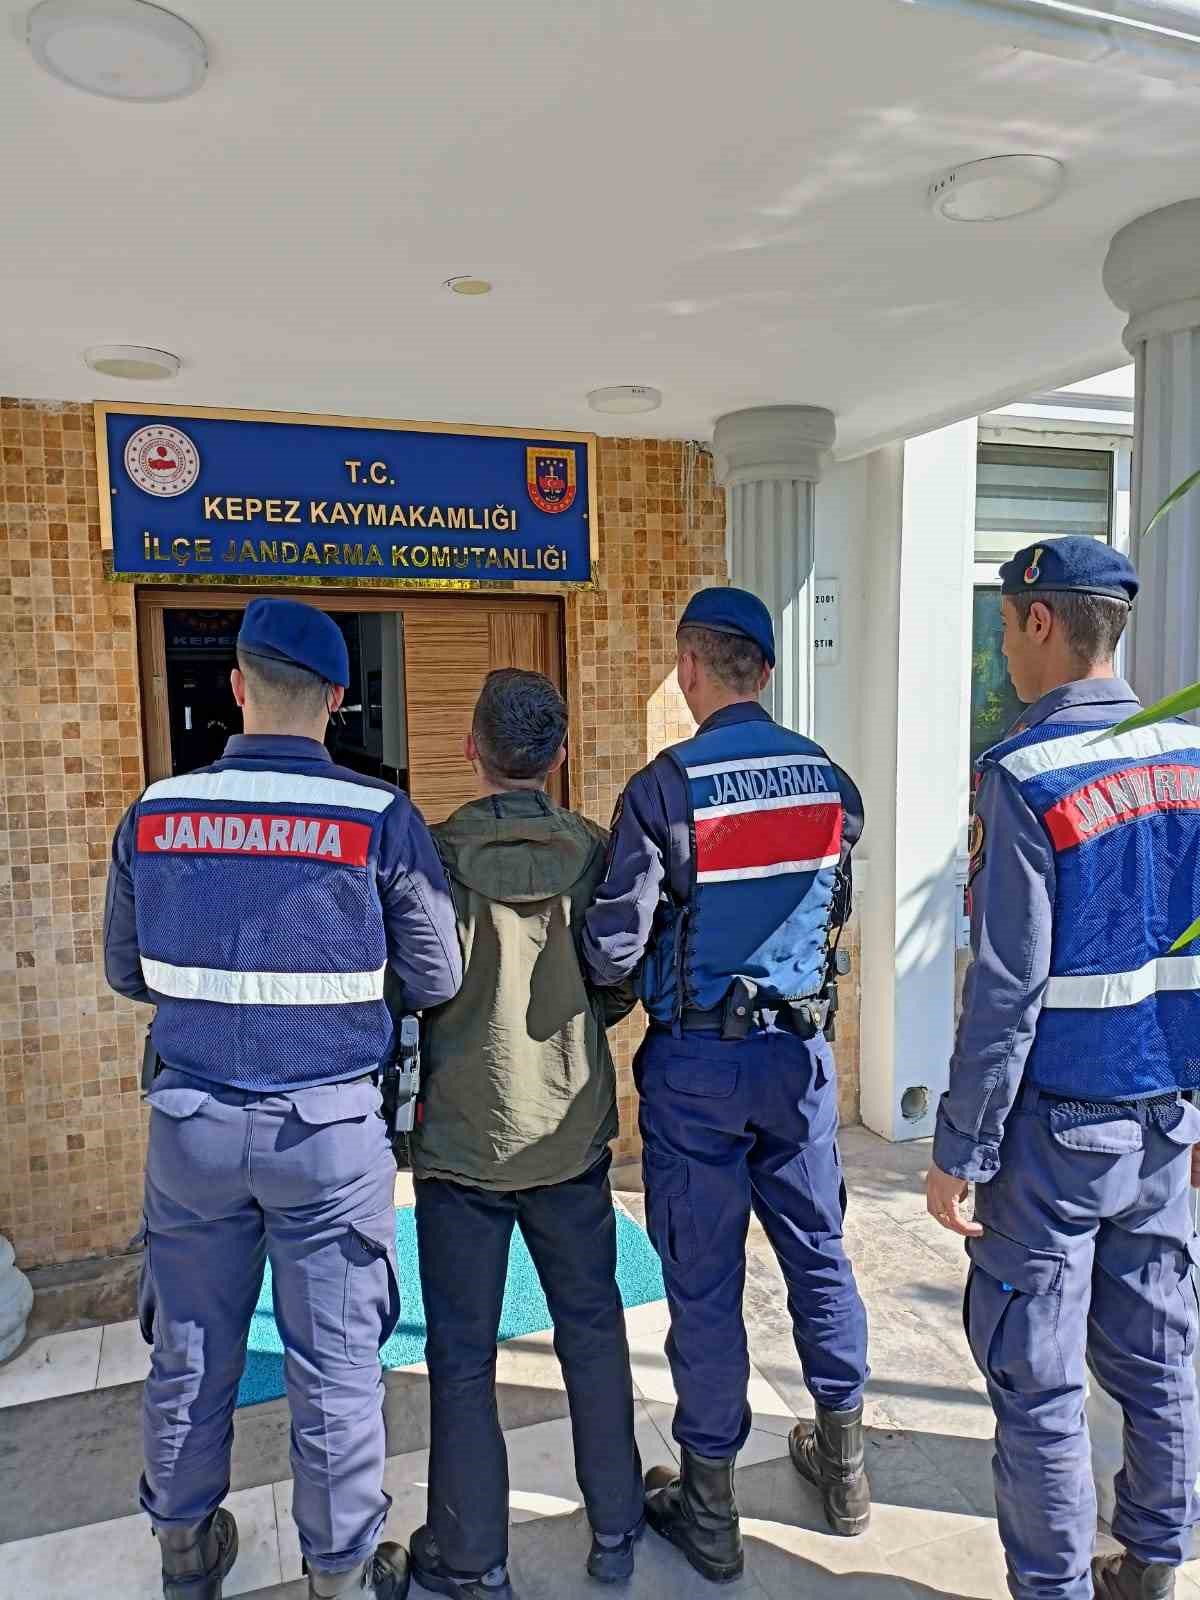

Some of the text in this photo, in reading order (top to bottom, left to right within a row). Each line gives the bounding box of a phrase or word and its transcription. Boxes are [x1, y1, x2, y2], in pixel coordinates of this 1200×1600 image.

[345, 460, 395, 485] T.C.
[204, 496, 517, 531] KEPEZ KAYMAKAMLIĞI
[144, 531, 567, 570] İLÇE JANDARMA KOMUTANLIĞI
[172, 635, 237, 646] KEPE
[708, 765, 829, 805] JANDARMA
[1075, 768, 1200, 833] JANRM
[154, 816, 342, 858] JANDARMA
